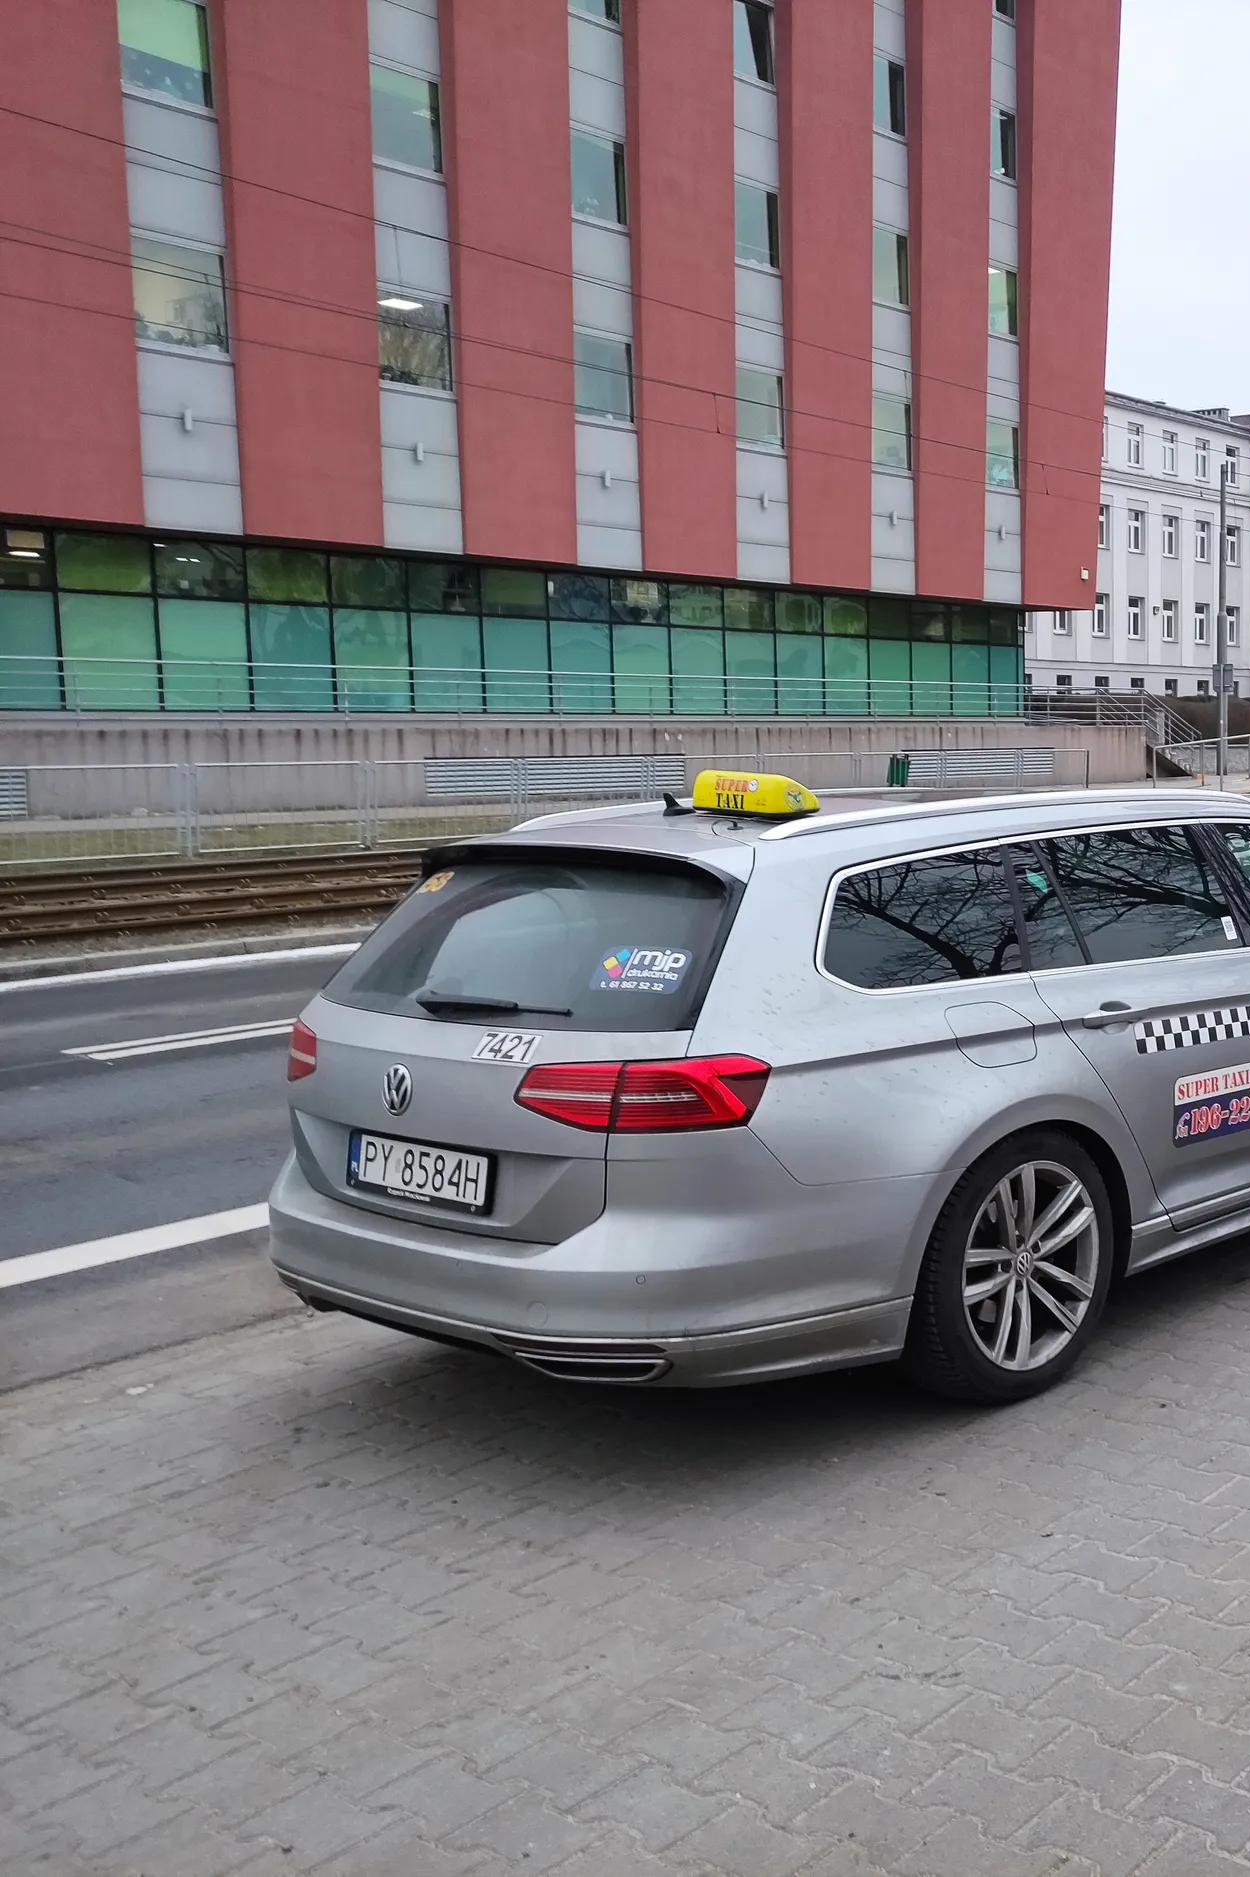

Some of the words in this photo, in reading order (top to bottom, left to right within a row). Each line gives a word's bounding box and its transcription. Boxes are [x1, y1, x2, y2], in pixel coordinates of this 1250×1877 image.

[714, 777, 749, 794] SUPER
[715, 792, 745, 810] TAXI
[632, 949, 687, 972] mjp
[477, 1032, 537, 1062] 7421
[1177, 1075, 1220, 1101] SUPER
[1222, 1069, 1250, 1090] TAXI
[363, 1140, 395, 1182] PY
[401, 1148, 481, 1201] 8584H
